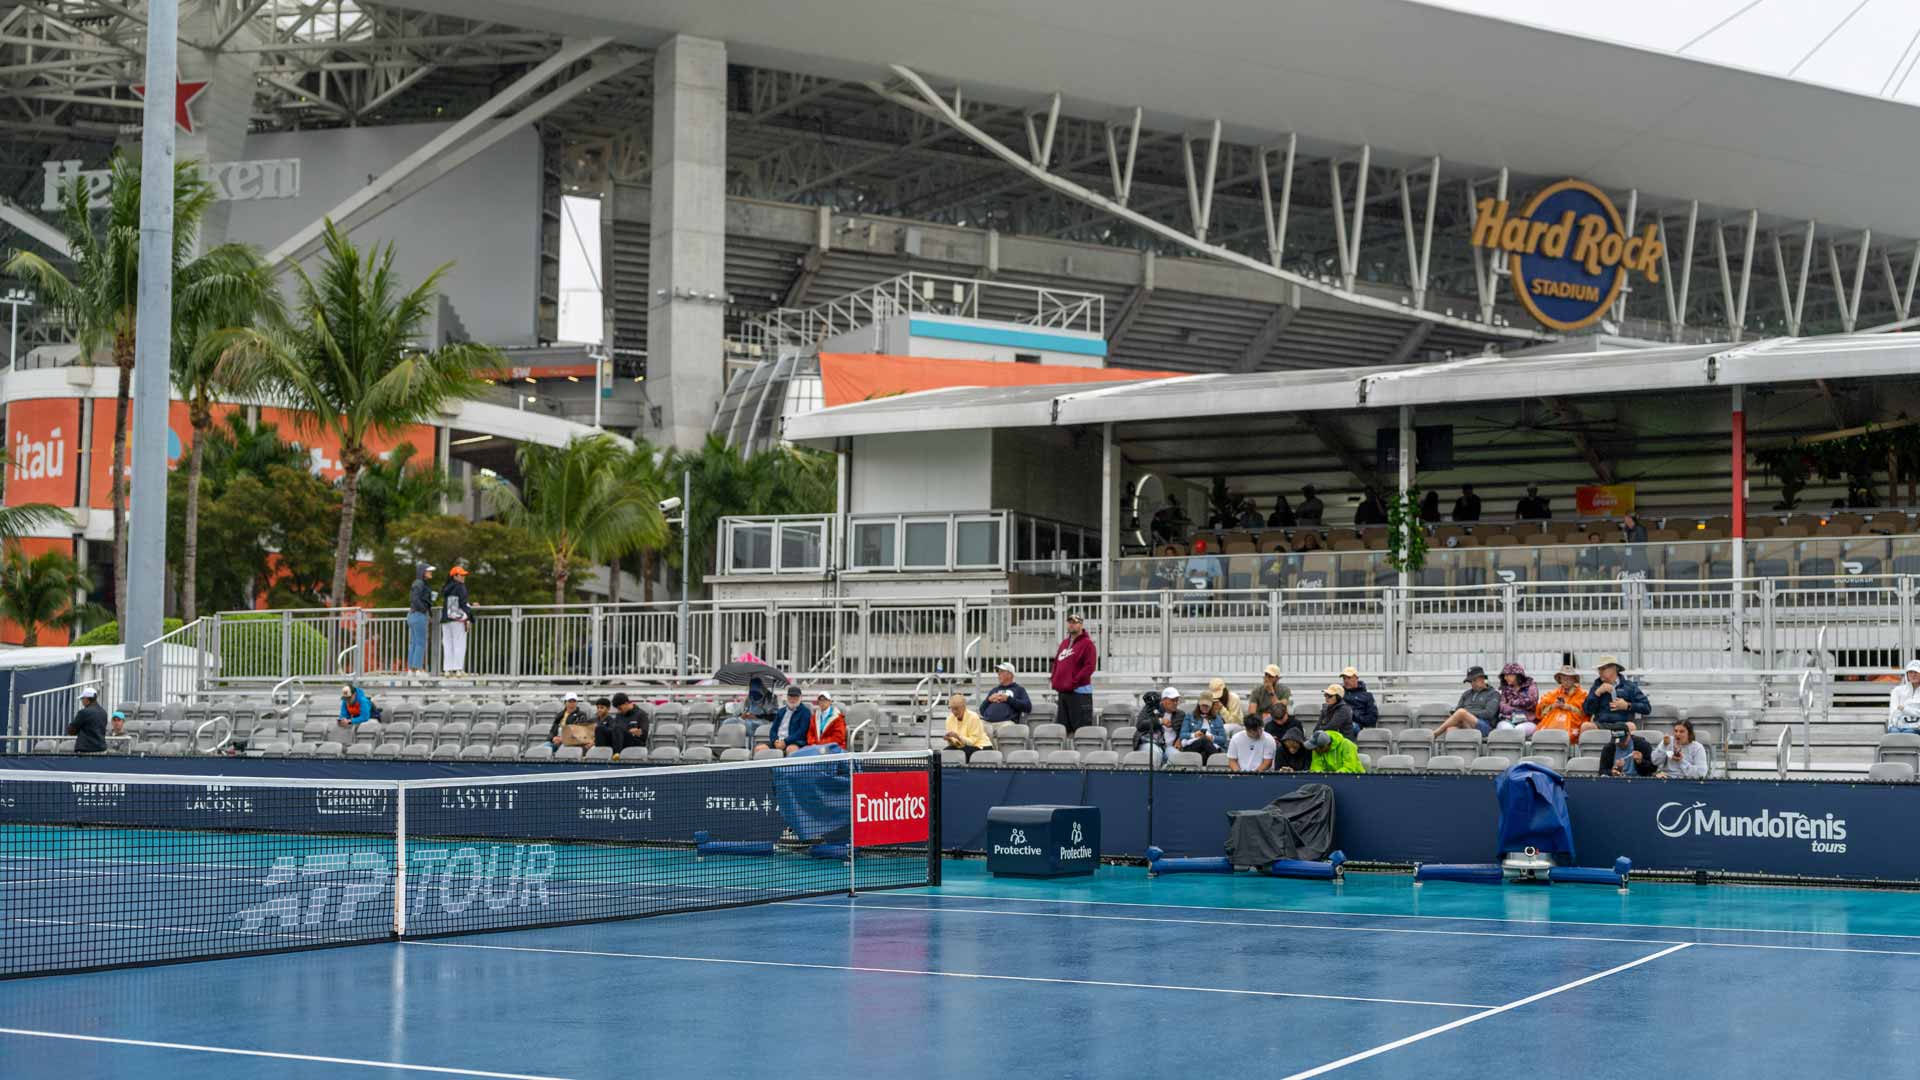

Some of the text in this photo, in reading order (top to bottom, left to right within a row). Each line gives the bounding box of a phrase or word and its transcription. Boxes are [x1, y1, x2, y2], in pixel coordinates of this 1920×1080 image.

[1472, 197, 1665, 283] Hard Rock
[1531, 278, 1600, 303] STADIUM
[13, 427, 65, 481] itaú
[576, 786, 599, 801] The
[186, 796, 254, 813] LACOSTE
[705, 796, 759, 811] STELLA
[856, 791, 926, 823] Emirates
[578, 806, 653, 823] Family Court
[1694, 808, 1847, 841] MundoTênis
[994, 845, 1042, 856] Protective
[1060, 846, 1093, 860] Protective
[1811, 839, 1847, 854] tours
[410, 843, 557, 917] TOUR
